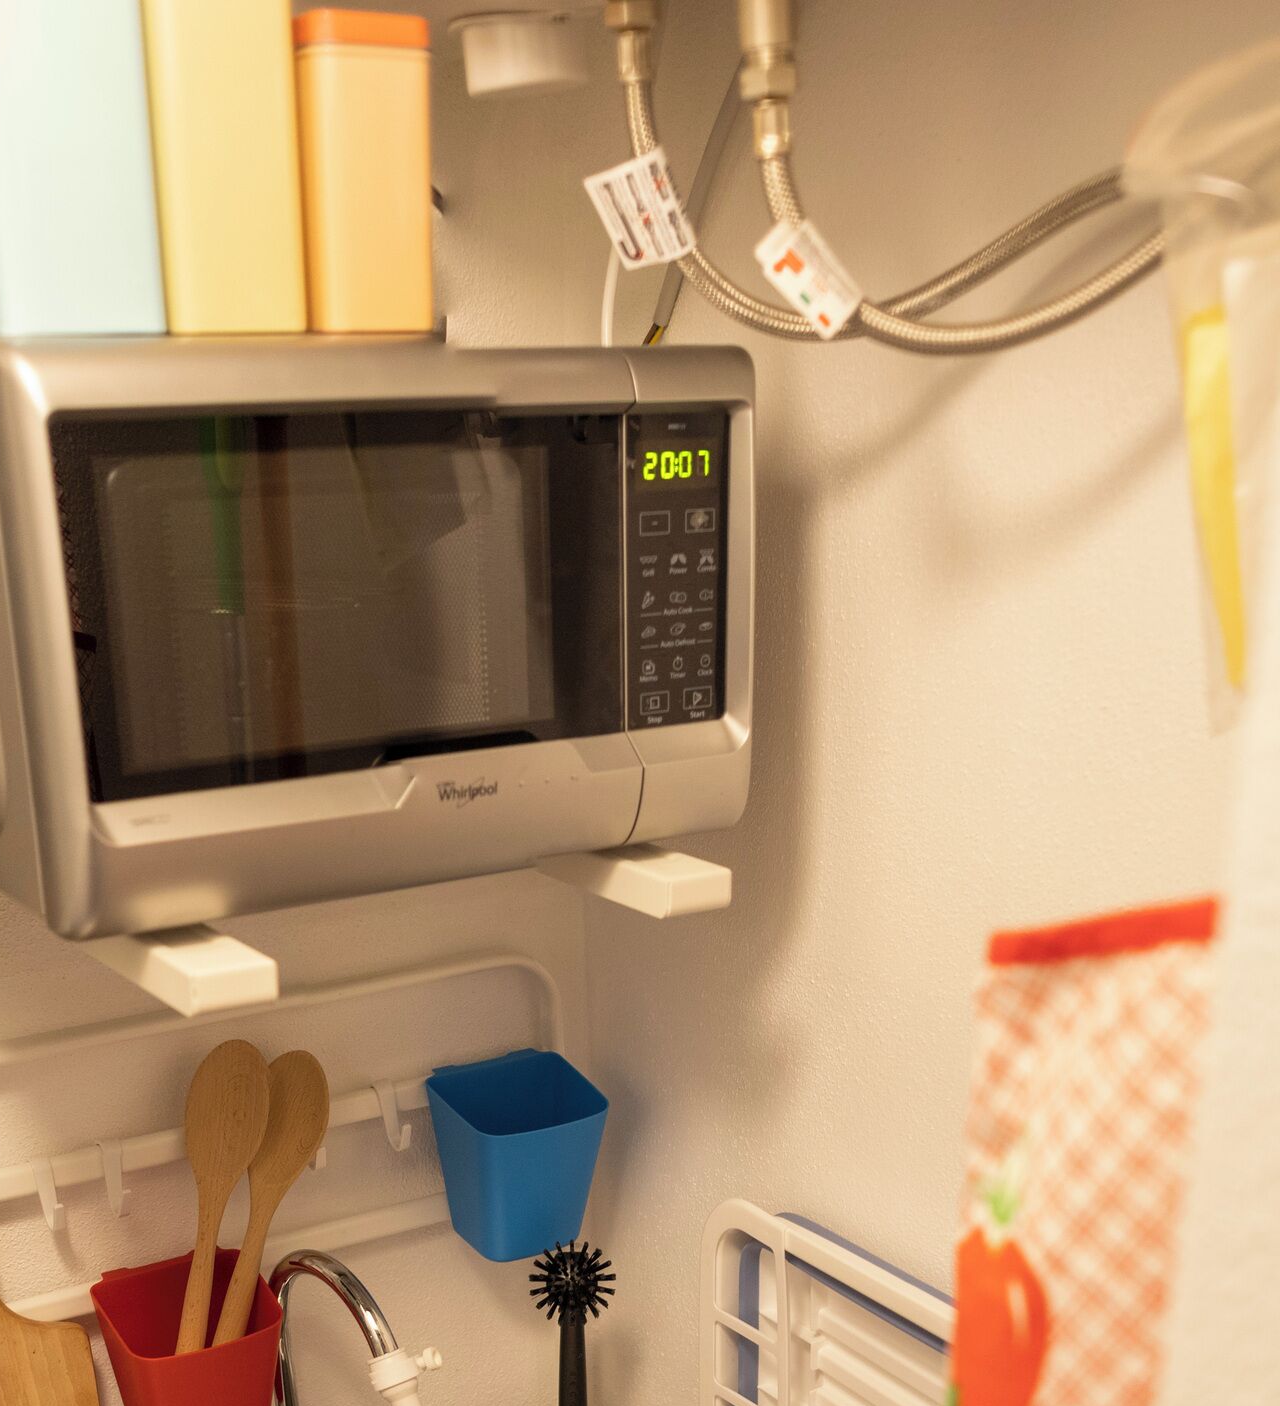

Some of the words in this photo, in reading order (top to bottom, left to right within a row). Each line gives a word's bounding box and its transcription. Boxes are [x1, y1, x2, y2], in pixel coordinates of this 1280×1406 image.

[643, 449, 710, 481] 20:07
[669, 567, 687, 575] Power
[660, 640, 674, 648] Auto
[670, 671, 686, 680] Timer
[697, 668, 713, 677] Clock
[690, 710, 705, 719] Start
[647, 715, 663, 724] Stop
[438, 779, 498, 804] Whirlpool
